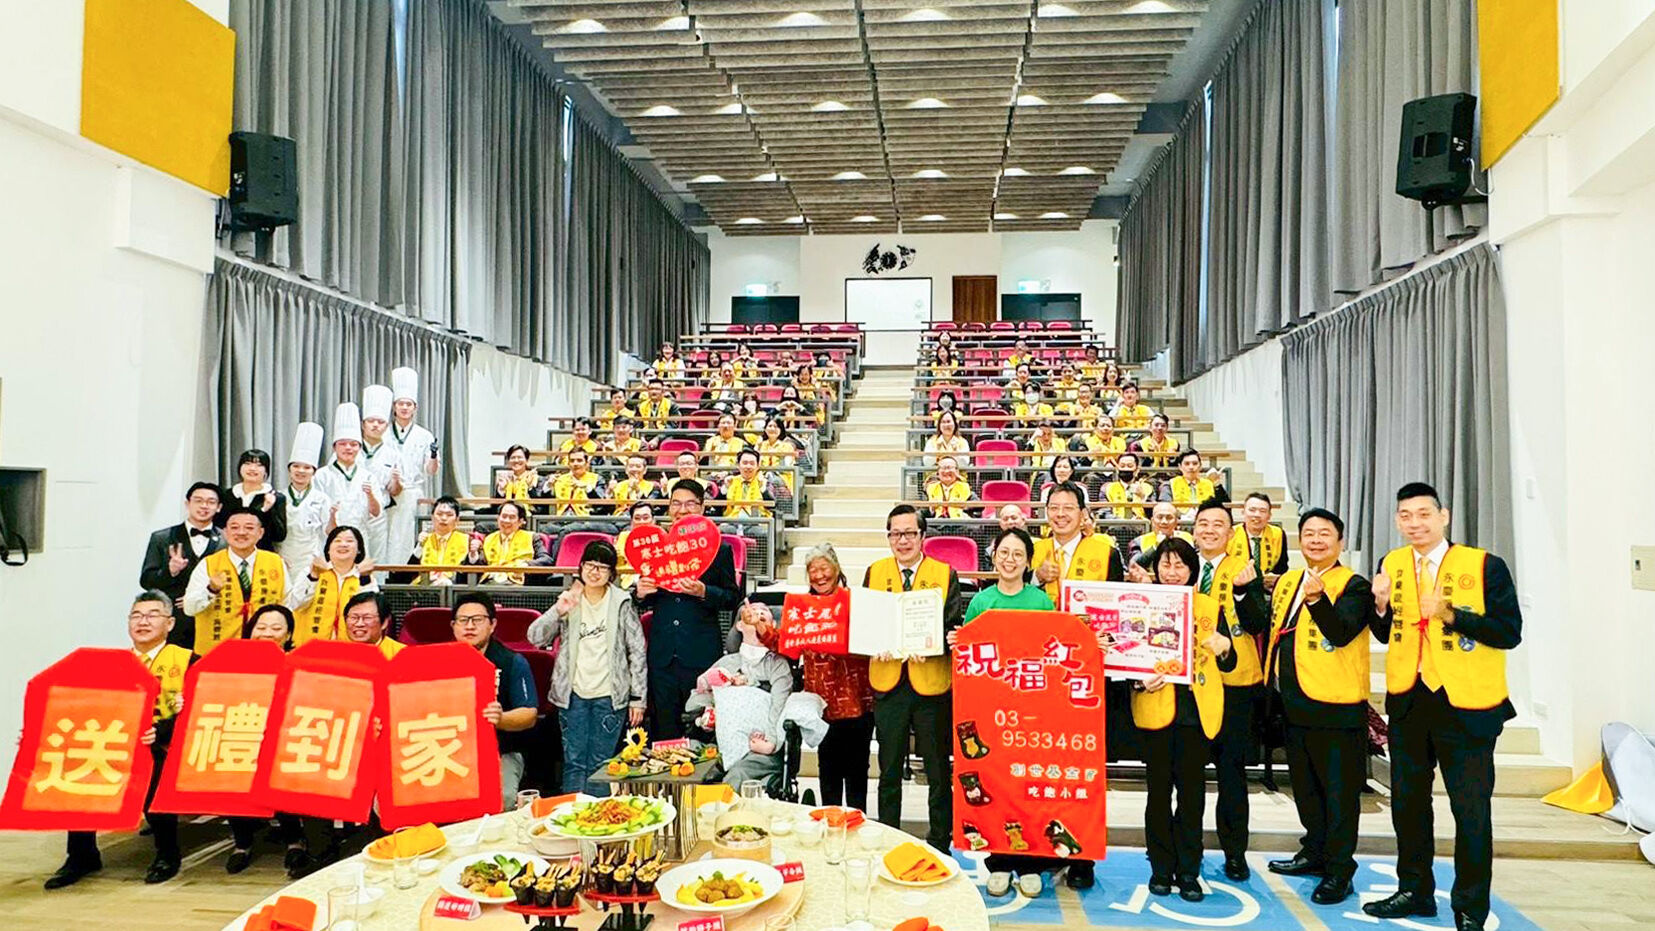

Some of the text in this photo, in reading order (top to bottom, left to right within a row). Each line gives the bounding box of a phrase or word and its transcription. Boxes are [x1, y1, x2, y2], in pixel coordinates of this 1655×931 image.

[641, 537, 708, 560] 寒士吃飽30
[955, 636, 1101, 709] 祝福紅包
[1002, 730, 1097, 751] 9533468
[1027, 785, 1089, 800] 吃飽小組
